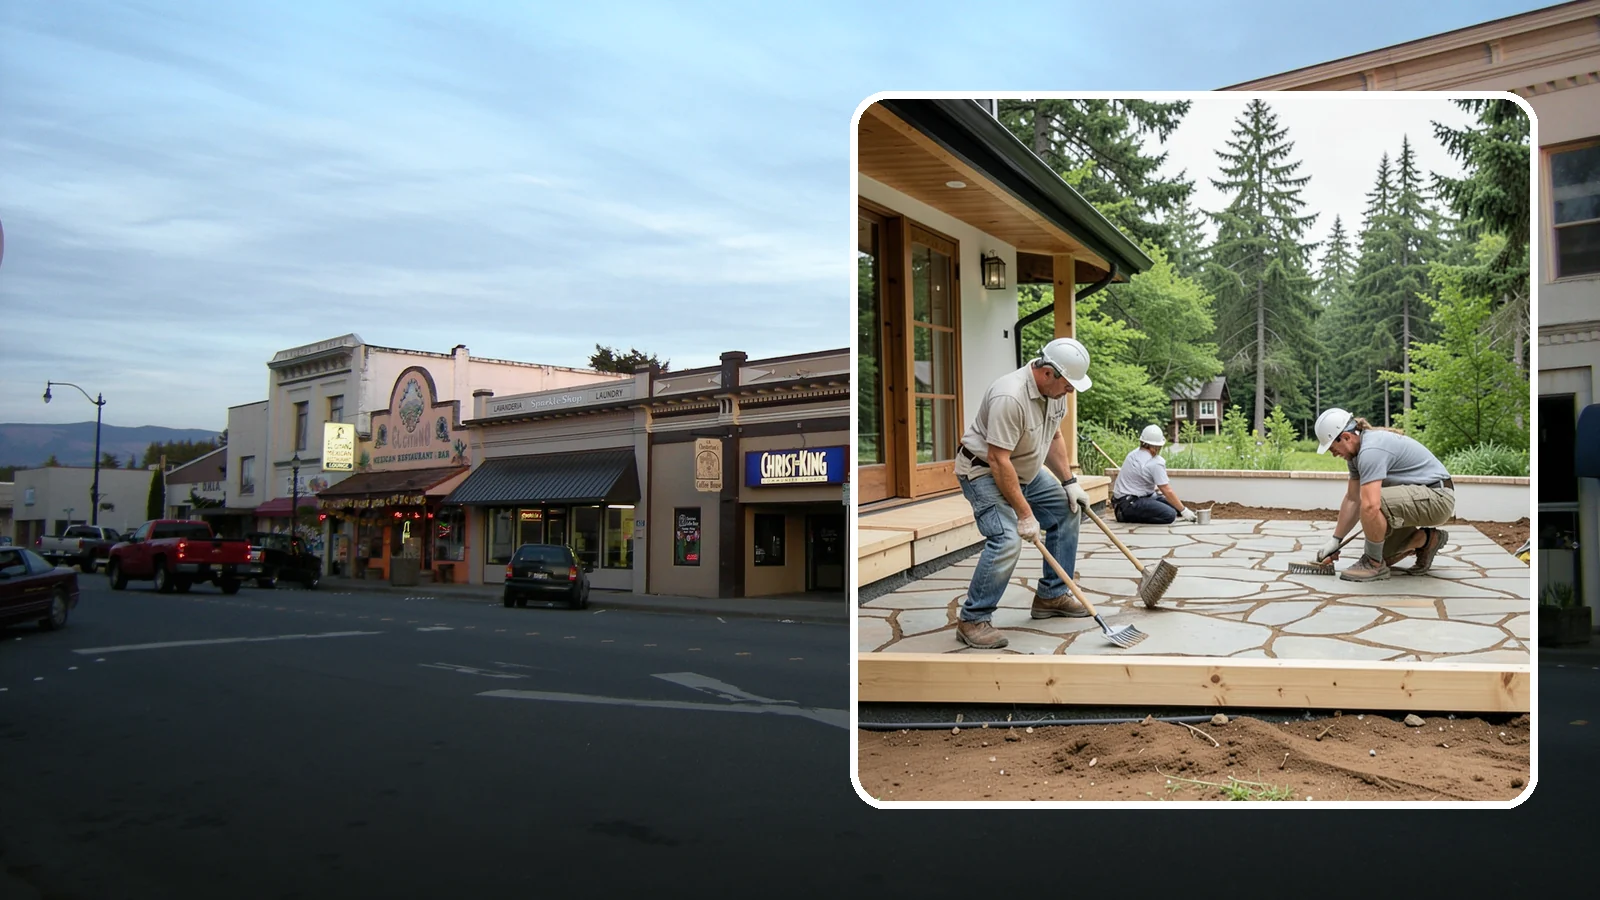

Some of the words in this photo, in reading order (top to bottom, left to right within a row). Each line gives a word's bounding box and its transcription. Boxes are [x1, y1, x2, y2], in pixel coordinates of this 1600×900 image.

[531, 398, 560, 408] Sparkle
[562, 394, 582, 405] Shop
[595, 389, 623, 400] LAUNDRY
[493, 402, 522, 412] LAVANDERIA
[374, 455, 396, 463] MEXICAN
[398, 452, 433, 462] RESTAURANT
[438, 450, 450, 459] BAR
[761, 452, 797, 478] CHRIST
[799, 450, 827, 476] KING
